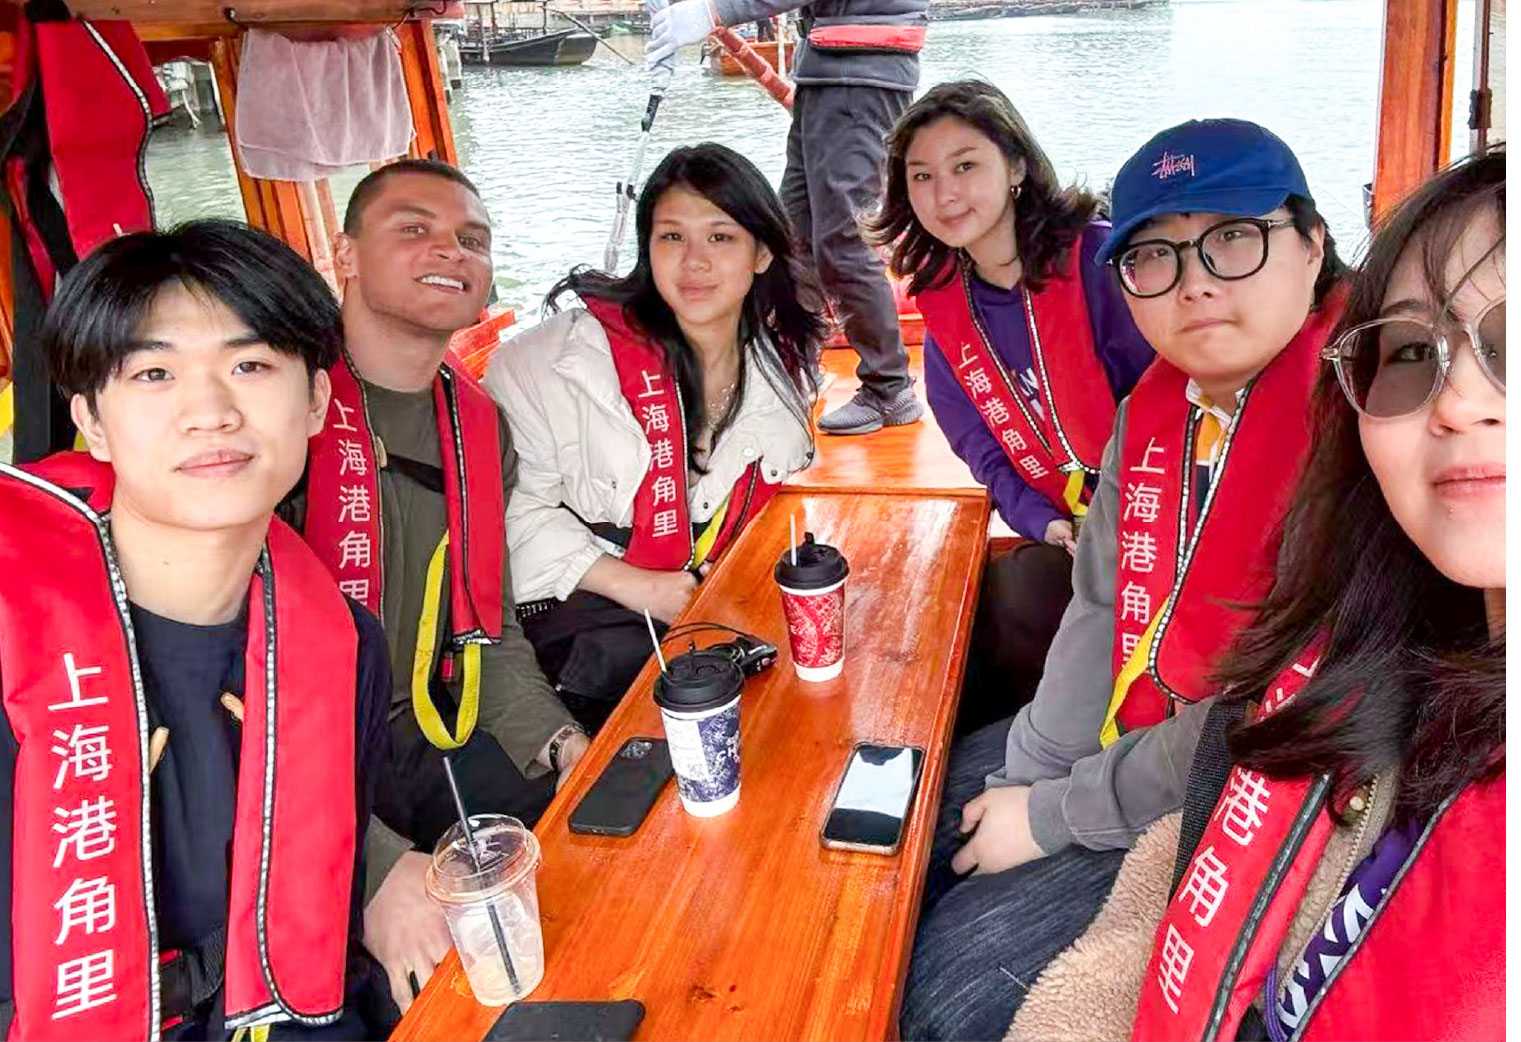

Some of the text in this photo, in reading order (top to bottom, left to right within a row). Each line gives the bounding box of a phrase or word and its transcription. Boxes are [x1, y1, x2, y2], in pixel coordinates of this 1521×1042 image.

[638, 370, 679, 538] 上海港角里
[958, 341, 1050, 479] 上海港角里
[47, 652, 118, 1021] 上海港角里
